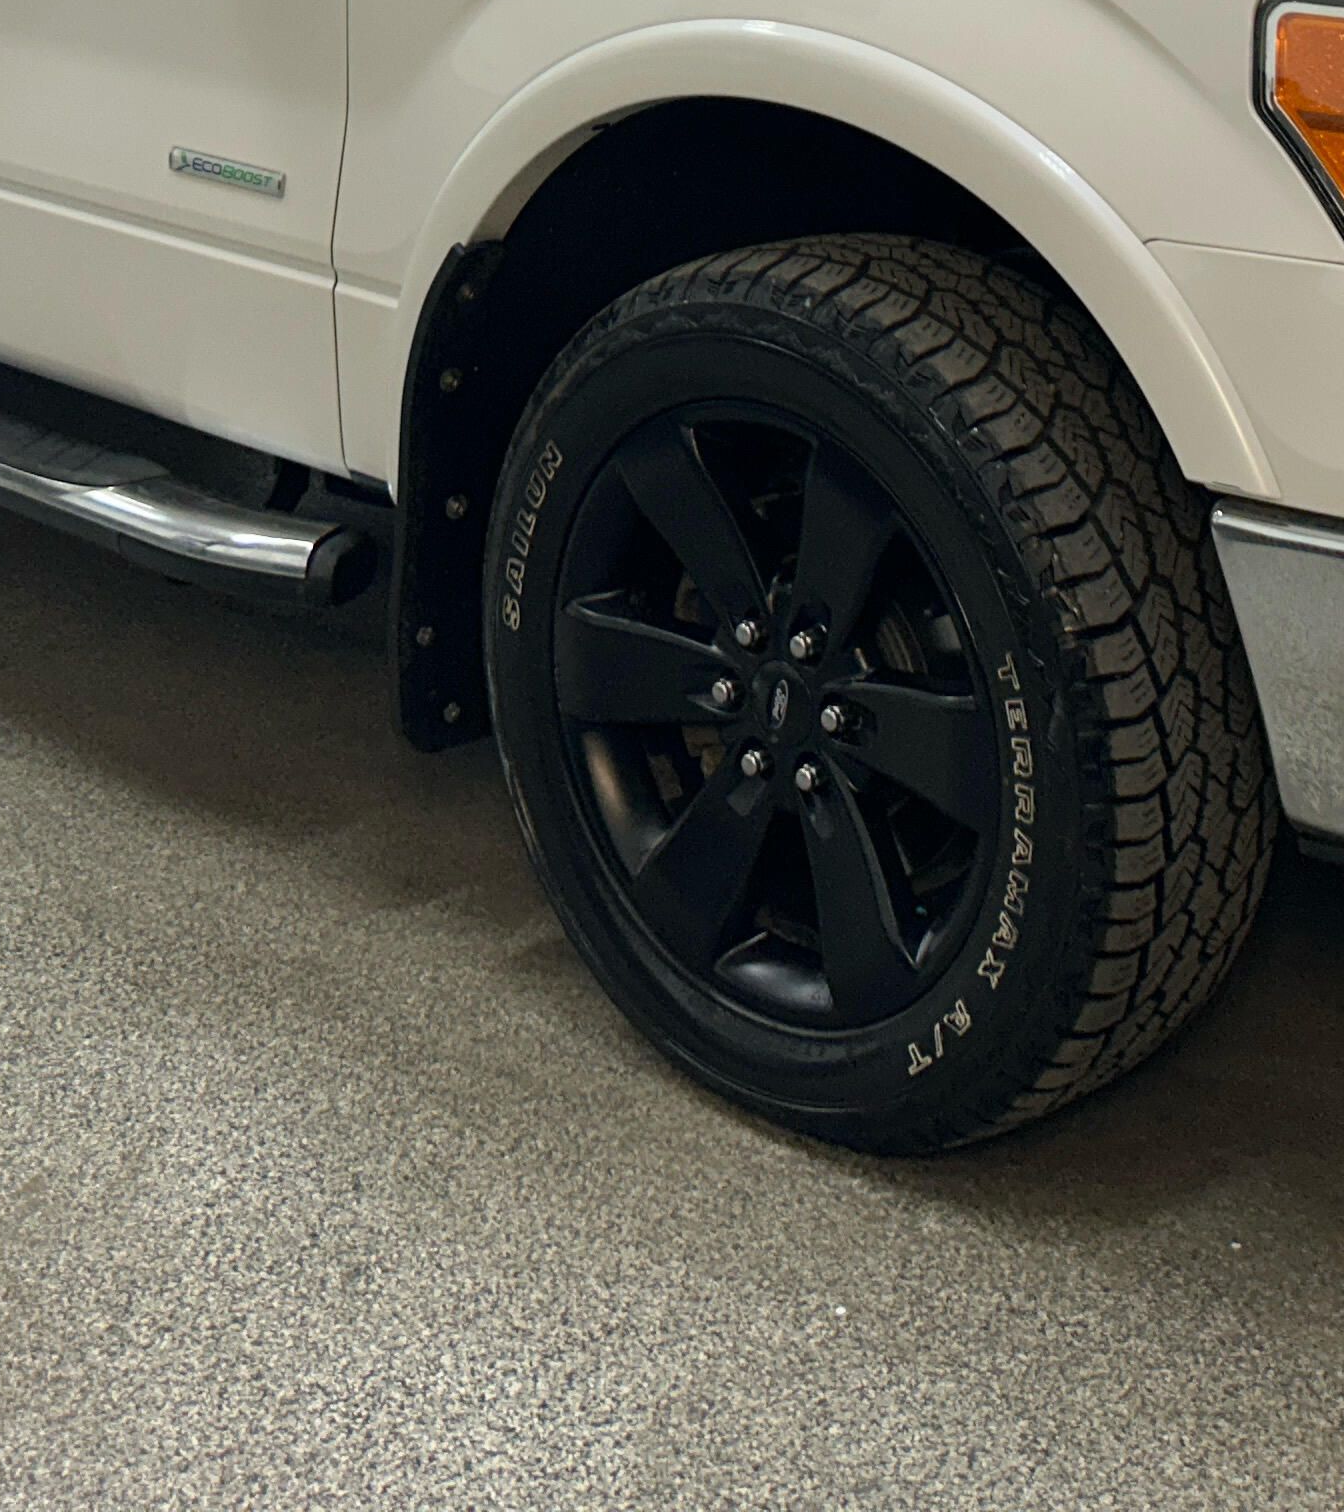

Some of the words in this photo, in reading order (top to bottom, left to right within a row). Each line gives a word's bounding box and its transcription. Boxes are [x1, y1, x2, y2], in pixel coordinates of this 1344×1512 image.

[191, 157, 273, 187] ECOBOOST
[501, 442, 563, 631] SAILUN
[977, 652, 1034, 990] TERRAMAX
[907, 998, 972, 1076] A/T
